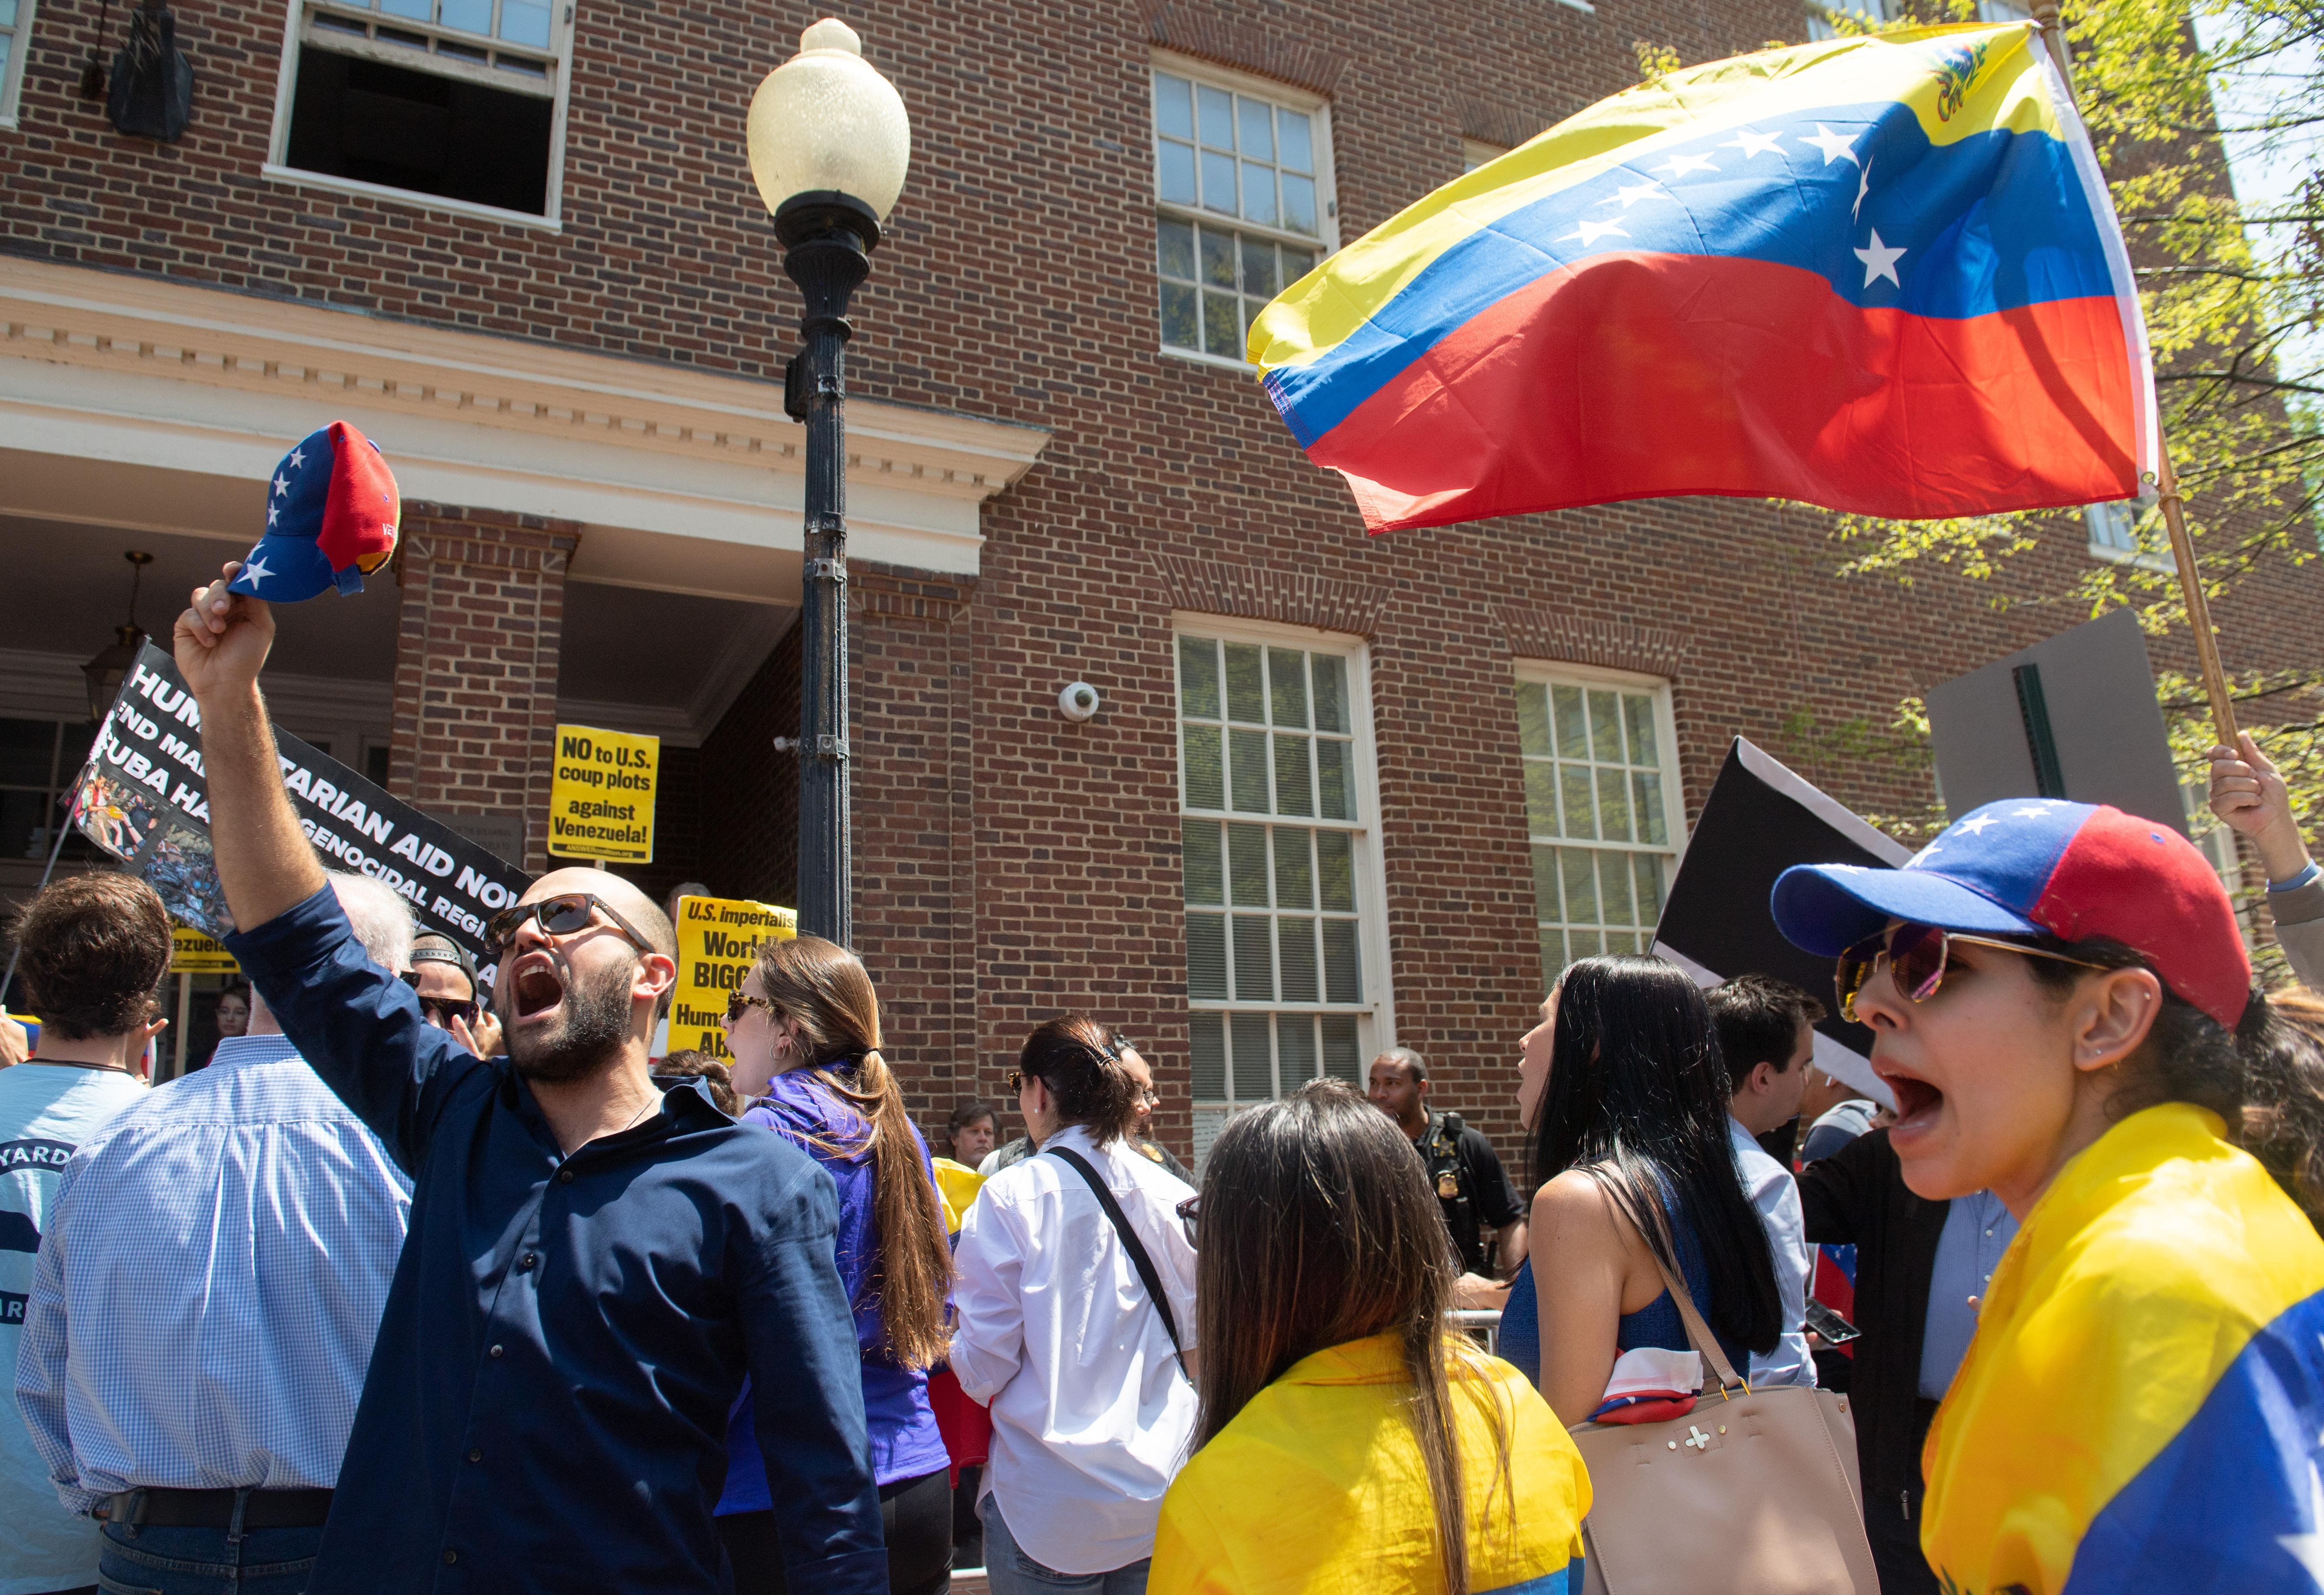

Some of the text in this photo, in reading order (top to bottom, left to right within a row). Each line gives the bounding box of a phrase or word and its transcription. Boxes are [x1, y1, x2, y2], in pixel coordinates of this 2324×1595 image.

[562, 736, 651, 769] NO to U.S.
[107, 731, 211, 824] UBA HA
[559, 766, 650, 791] coup plots
[568, 799, 635, 821] against
[158, 733, 206, 778] MA
[300, 819, 427, 907] GENOCIDAL
[431, 895, 486, 941] REGI
[554, 816, 647, 843] Venezuela!
[389, 833, 455, 877] AID
[688, 902, 716, 921] U.S.
[694, 962, 751, 990] BIGG
[699, 1032, 735, 1059] Ab
